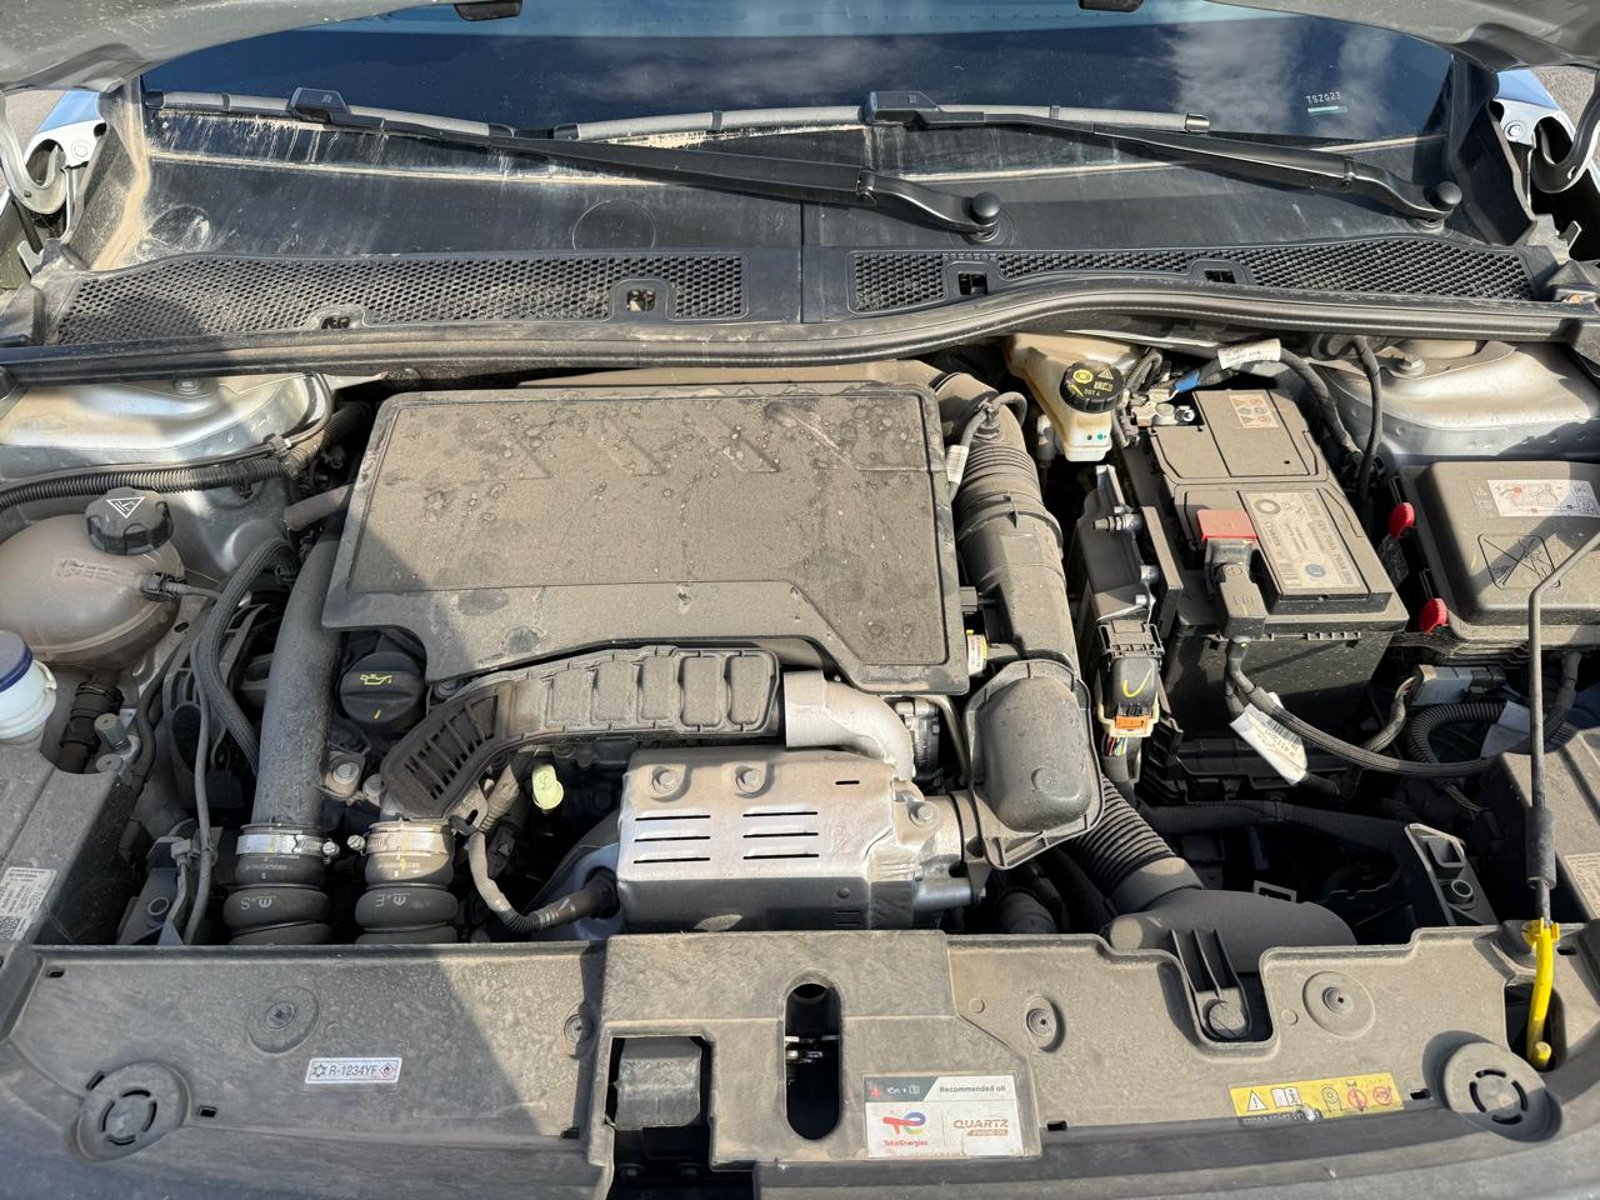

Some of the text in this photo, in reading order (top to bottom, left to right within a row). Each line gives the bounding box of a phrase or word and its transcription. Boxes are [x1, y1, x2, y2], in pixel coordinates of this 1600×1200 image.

[329, 1064, 377, 1076] R-1234YF
[953, 1119, 1009, 1129] QUARTZ
[884, 1139, 928, 1147] TotalEnergies
